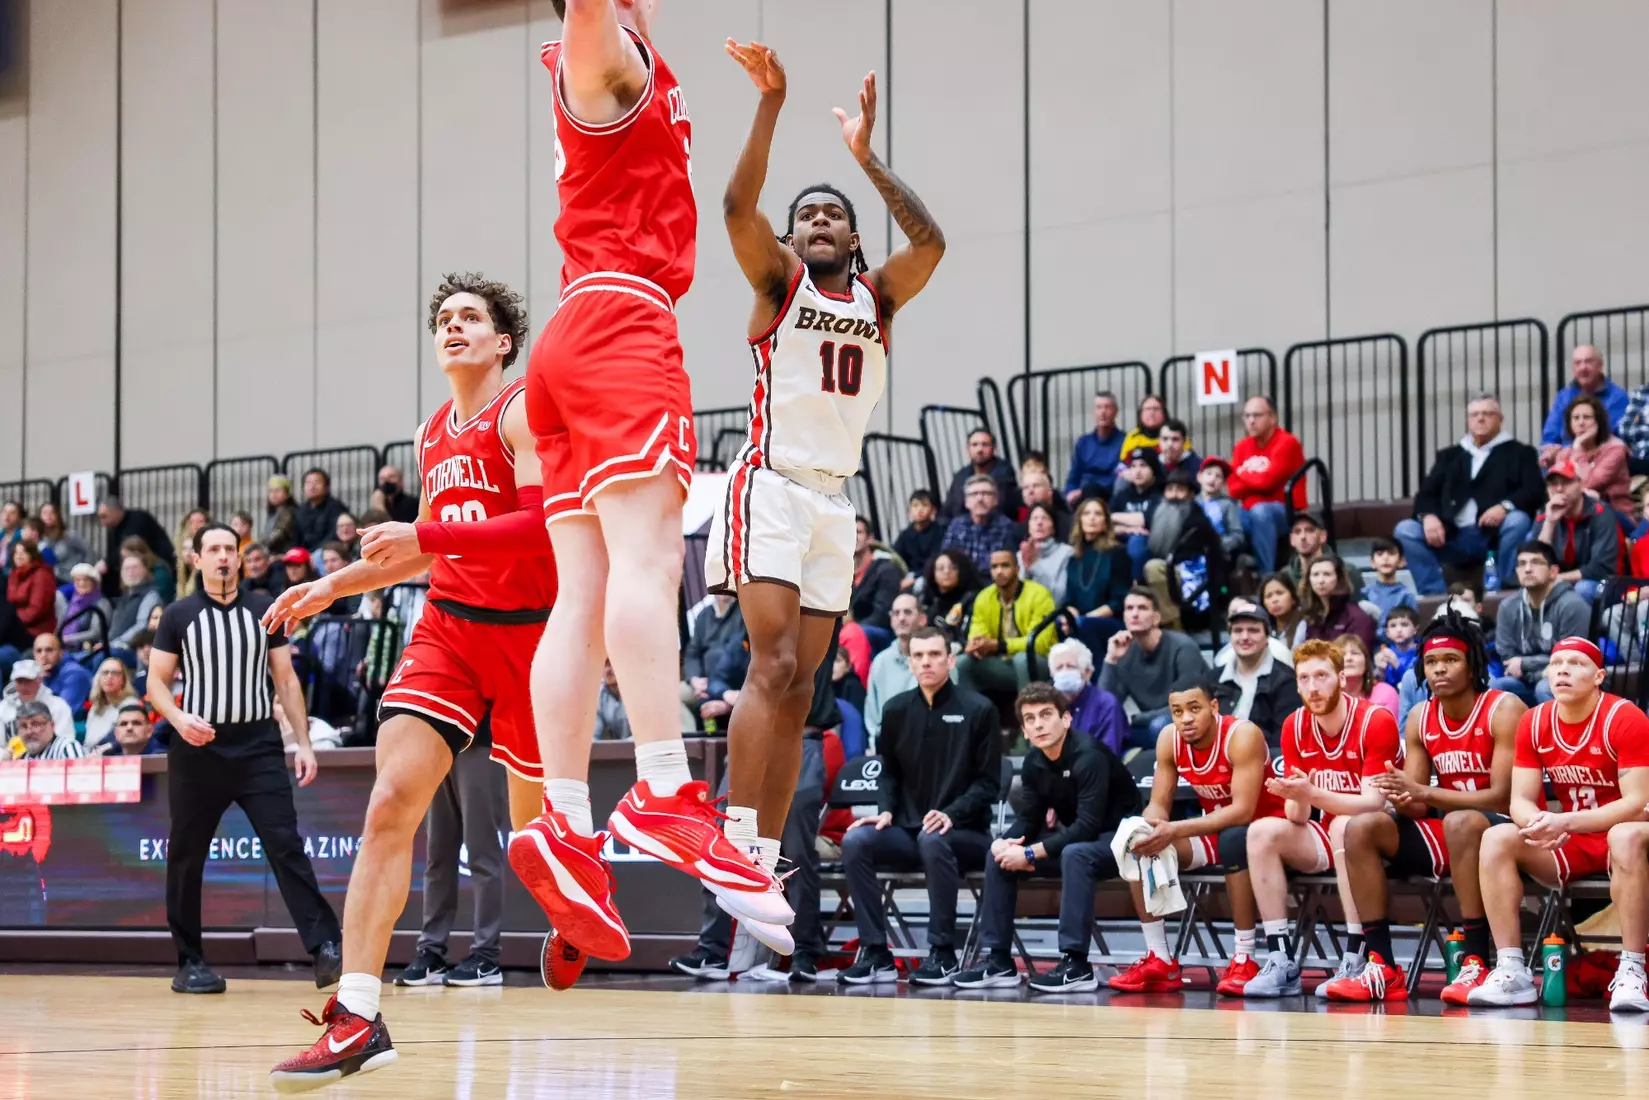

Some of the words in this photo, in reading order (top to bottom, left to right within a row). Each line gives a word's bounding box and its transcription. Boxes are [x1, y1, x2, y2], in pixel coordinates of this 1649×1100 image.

[819, 340, 864, 397] 10
[1203, 360, 1230, 395] N
[679, 415, 690, 453] C
[75, 481, 88, 506] L
[426, 454, 501, 506] CORNELL
[390, 659, 415, 685] C
[1568, 785, 1599, 812] 13
